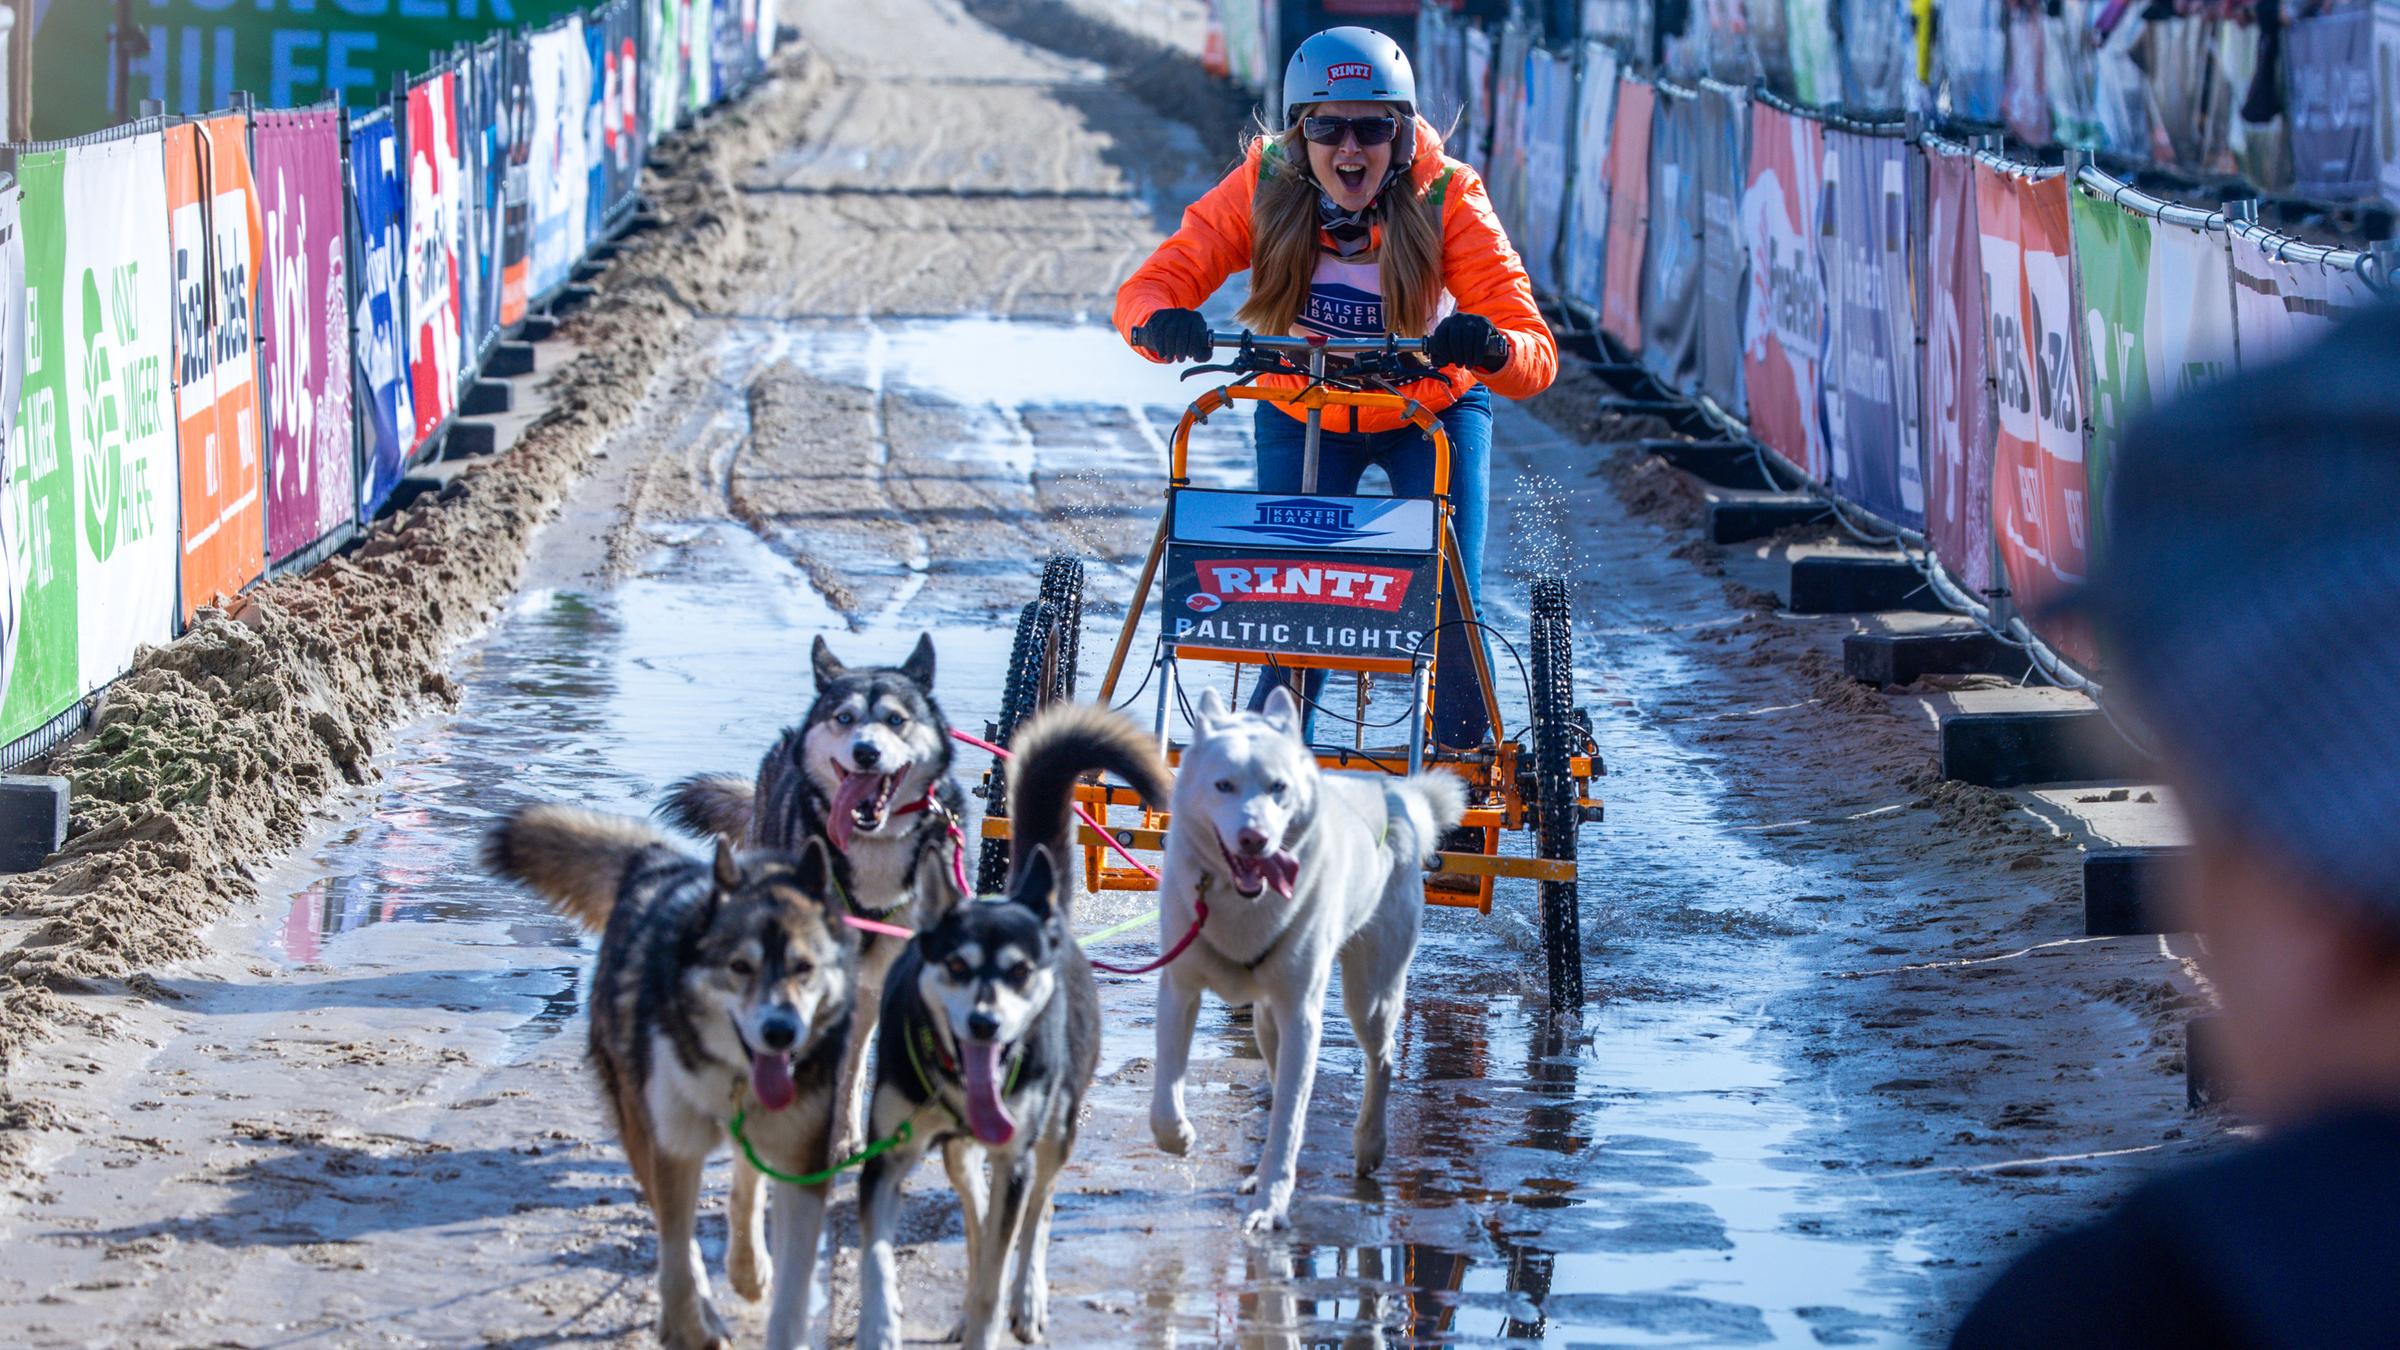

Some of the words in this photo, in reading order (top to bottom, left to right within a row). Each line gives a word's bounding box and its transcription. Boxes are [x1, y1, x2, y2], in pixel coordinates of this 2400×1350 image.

[1330, 64, 1370, 78] RINTI
[1311, 298, 1377, 316] KAISER
[1311, 308, 1377, 326] BÄDER
[1273, 508, 1336, 519] KAISER
[1273, 515, 1336, 525] BÄDER
[1211, 566, 1394, 602] RINTI
[1175, 617, 1290, 644] BALTIC
[1306, 625, 1424, 650] LIGHTS
